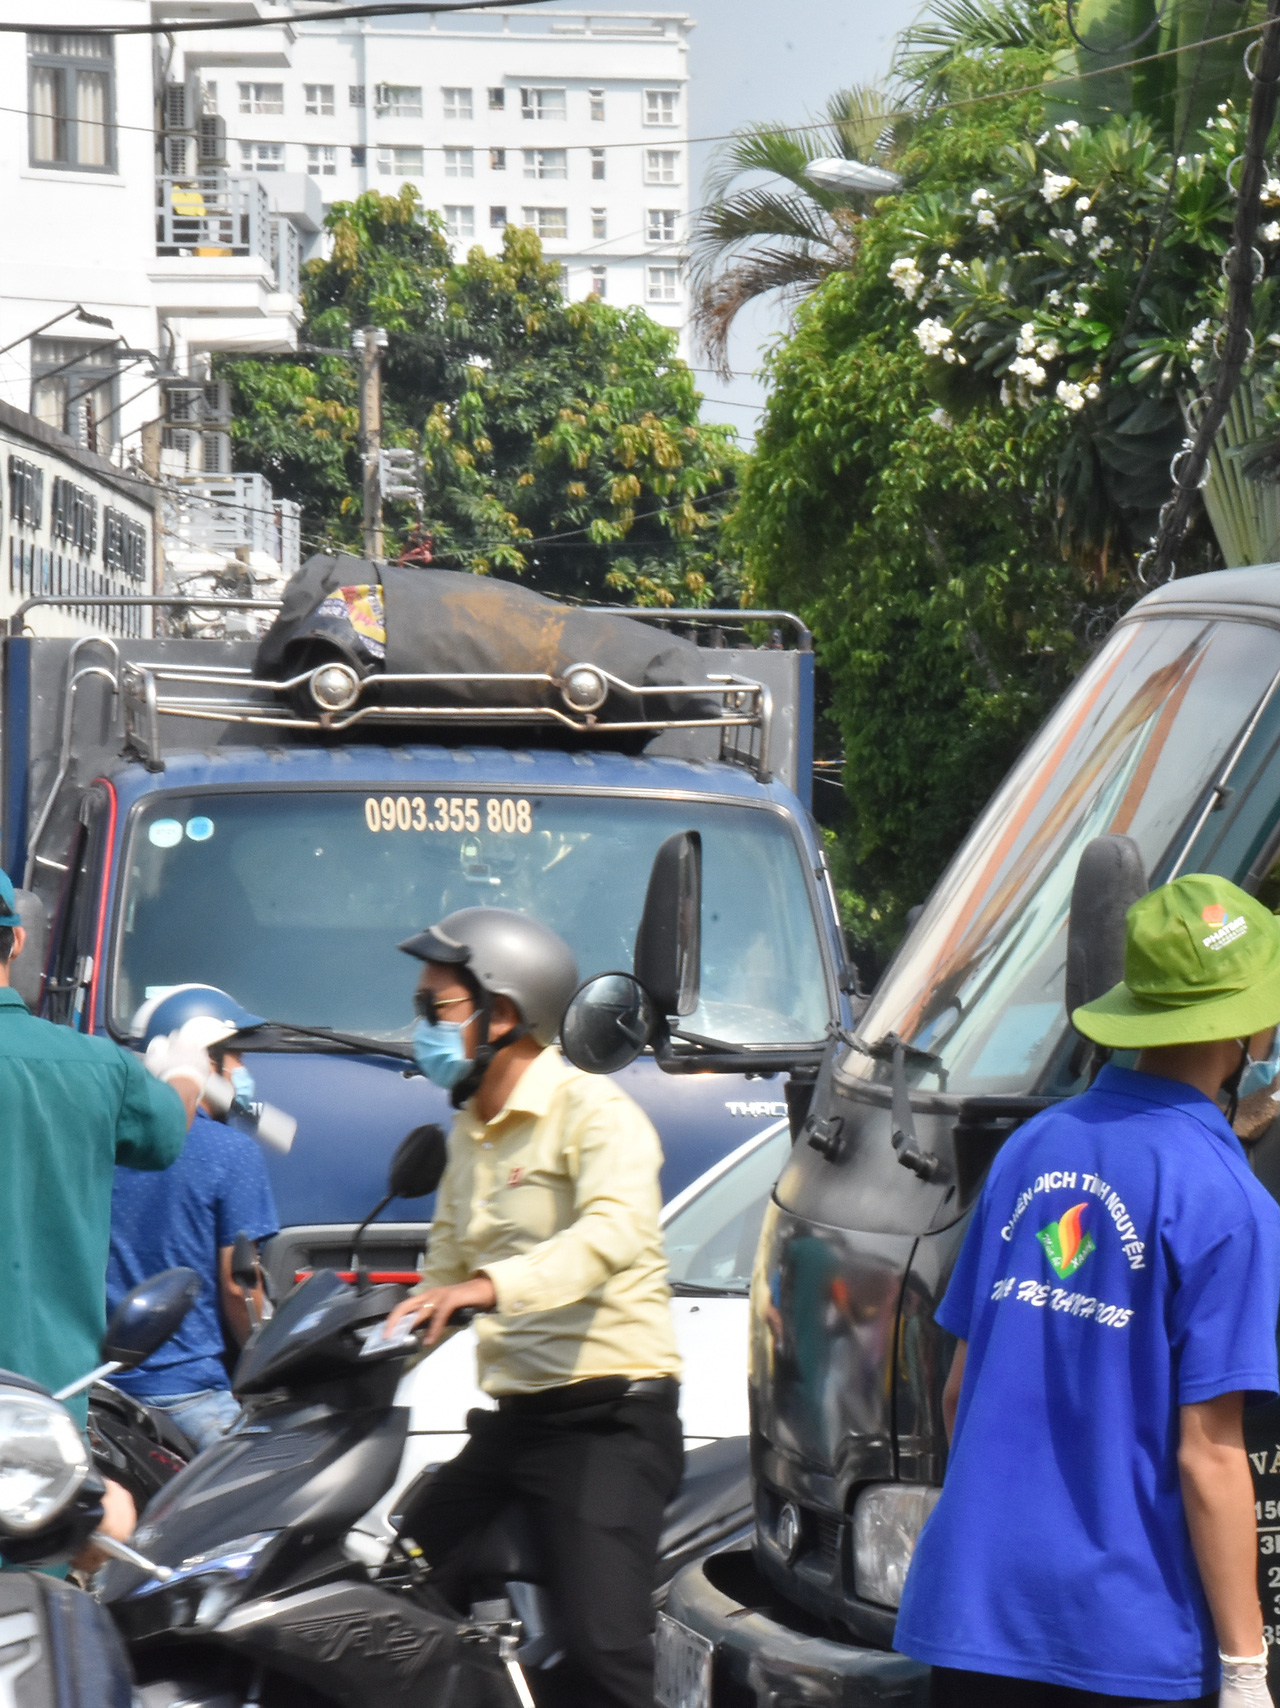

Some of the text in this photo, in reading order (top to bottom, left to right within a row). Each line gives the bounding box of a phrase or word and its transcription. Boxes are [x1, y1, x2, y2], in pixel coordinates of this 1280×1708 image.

[364, 796, 533, 834] 0903.355 808
[1034, 1171, 1077, 1193] DỊCH
[1105, 1191, 1146, 1270] NGUYỆN
